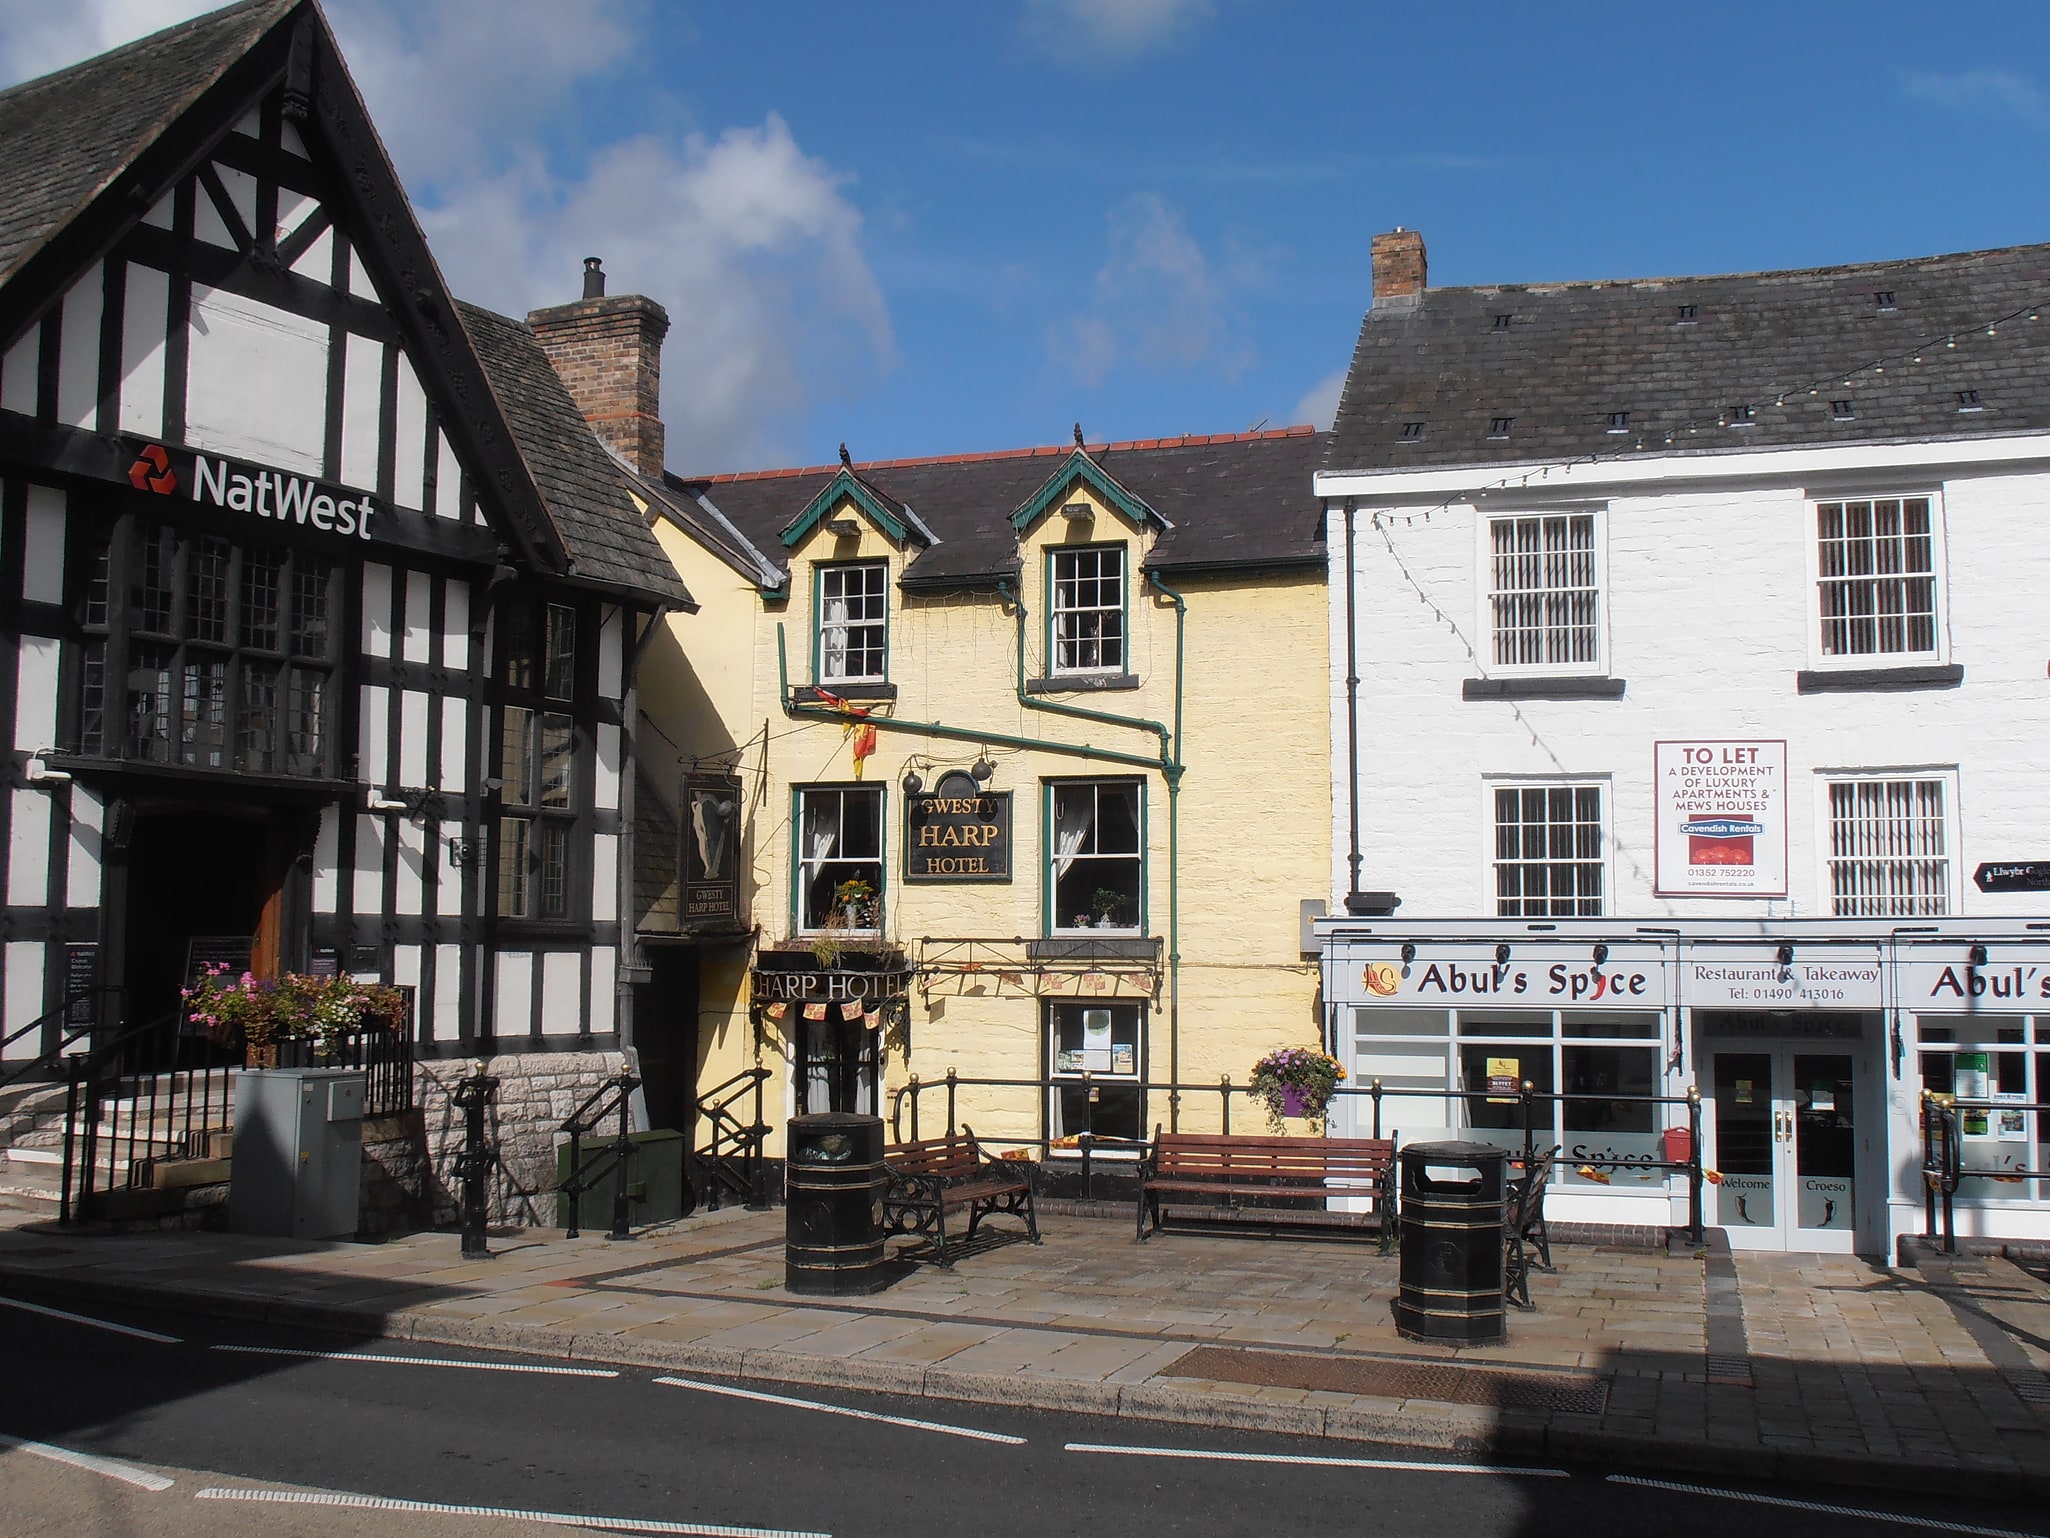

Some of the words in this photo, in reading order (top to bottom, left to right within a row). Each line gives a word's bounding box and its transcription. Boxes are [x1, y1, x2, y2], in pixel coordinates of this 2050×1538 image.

[192, 455, 374, 540] NatWest
[1683, 747, 1713, 764] TO
[1723, 747, 1759, 764] LET
[1668, 767, 1677, 776] A
[1680, 766, 1775, 776] DEVELOPMENT
[1684, 778, 1702, 788] OF
[1705, 778, 1758, 788] LUXURY
[1672, 789, 1757, 799] APARTMENTS
[1760, 789, 1770, 799] &
[921, 798, 996, 814] GWESTY
[1675, 801, 1712, 811] MEWS
[1716, 800, 1767, 811] HOUSES
[1681, 824, 1728, 833] Cavendish
[1729, 824, 1761, 833] Rentals
[918, 825, 999, 847] HARP
[926, 857, 990, 873] HOTEL
[1688, 868, 1717, 877] 01352
[1719, 868, 1755, 877] 752220
[696, 889, 724, 900] GWESTY
[688, 902, 708, 913] HARP
[708, 901, 730, 912] HOTEL
[1695, 965, 1776, 981] Restaurant
[1784, 967, 1795, 981] &
[1803, 966, 1879, 984] Takeaway
[759, 974, 817, 999] HARP
[1417, 963, 1528, 993] Abul's
[1548, 964, 1647, 1000] Spice
[1930, 966, 2050, 998] Abul's
[1728, 987, 1749, 999] Tel:
[1753, 988, 1792, 999] 01490
[1799, 988, 1844, 1000] 413016
[1720, 1178, 1771, 1190] Welcome
[1806, 1180, 1846, 1192] Croeso
